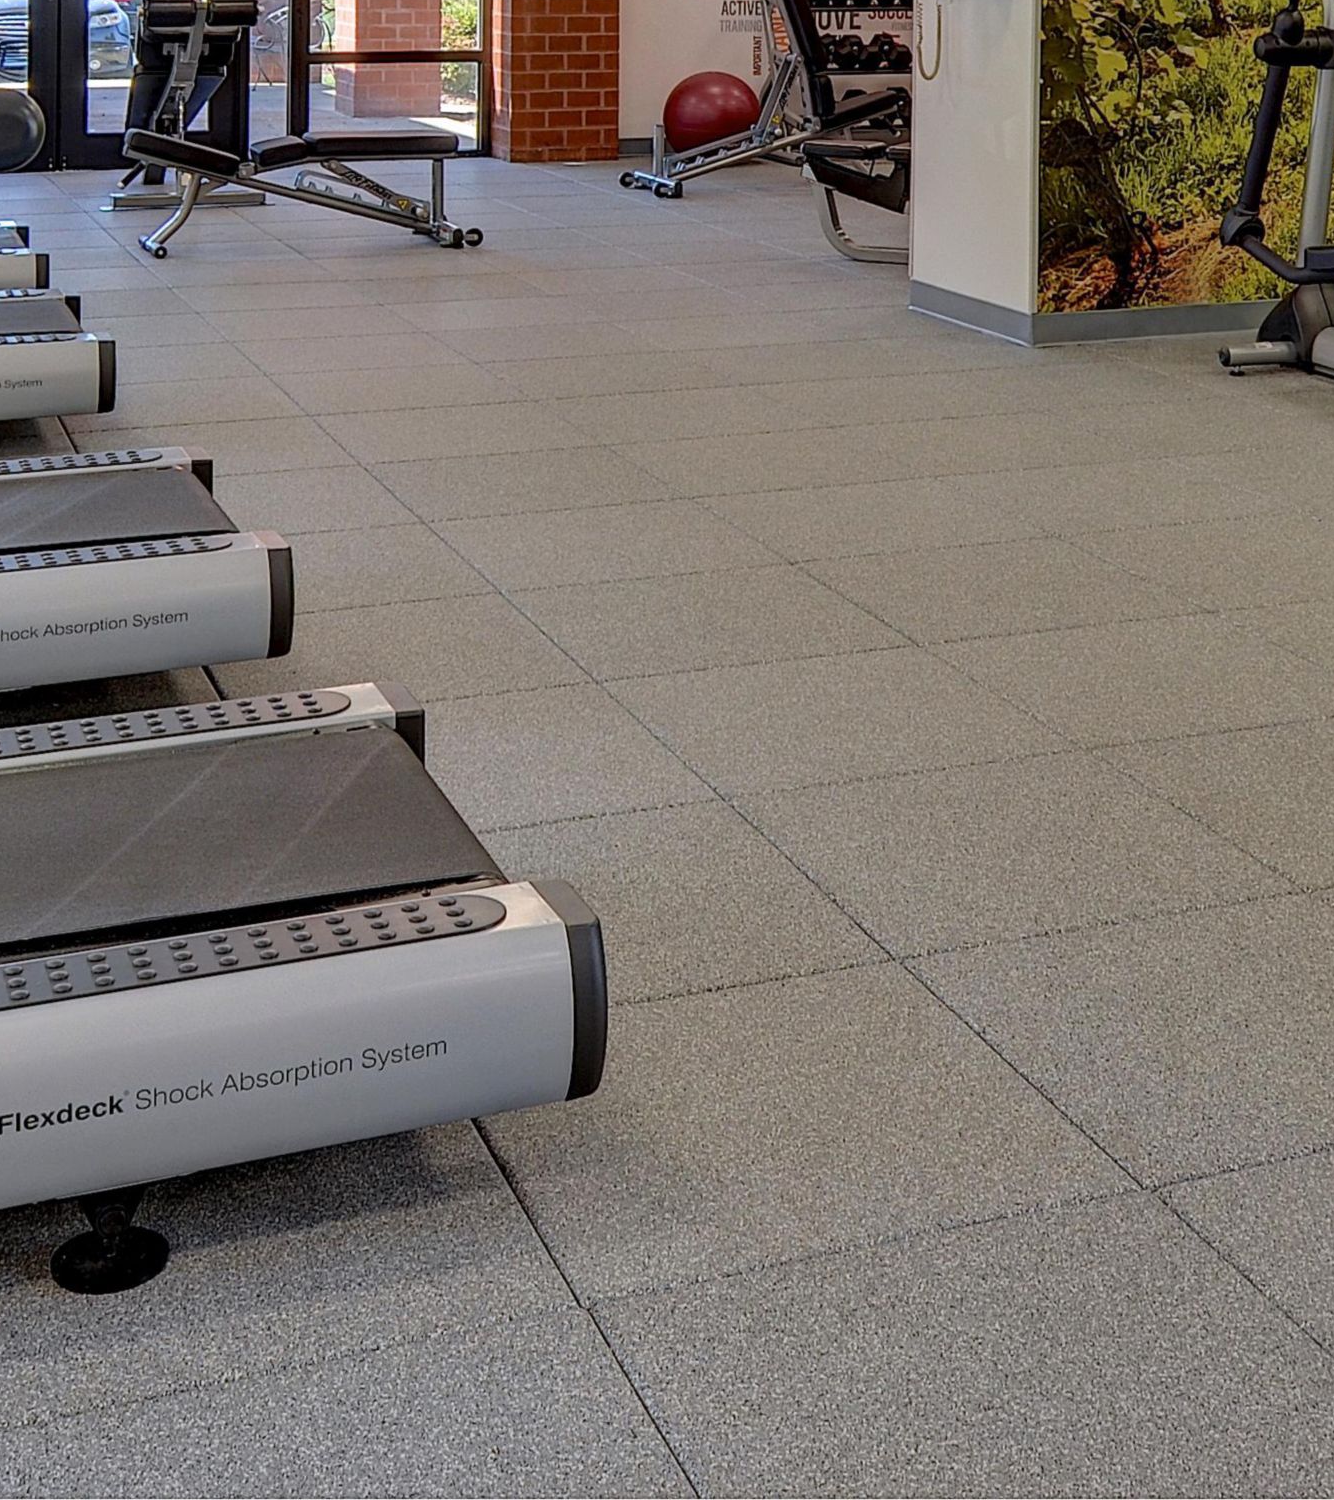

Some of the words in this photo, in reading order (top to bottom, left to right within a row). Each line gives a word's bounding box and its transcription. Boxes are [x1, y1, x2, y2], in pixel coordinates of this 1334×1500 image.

[721, 0, 762, 16] ACTIVE
[720, 20, 763, 33] TRAINING
[3, 378, 43, 390] System
[42, 616, 128, 637] Absorption
[132, 610, 188, 629] System
[135, 1078, 214, 1111] Shock
[220, 1054, 354, 1097] Absorption
[360, 1038, 449, 1072] System
